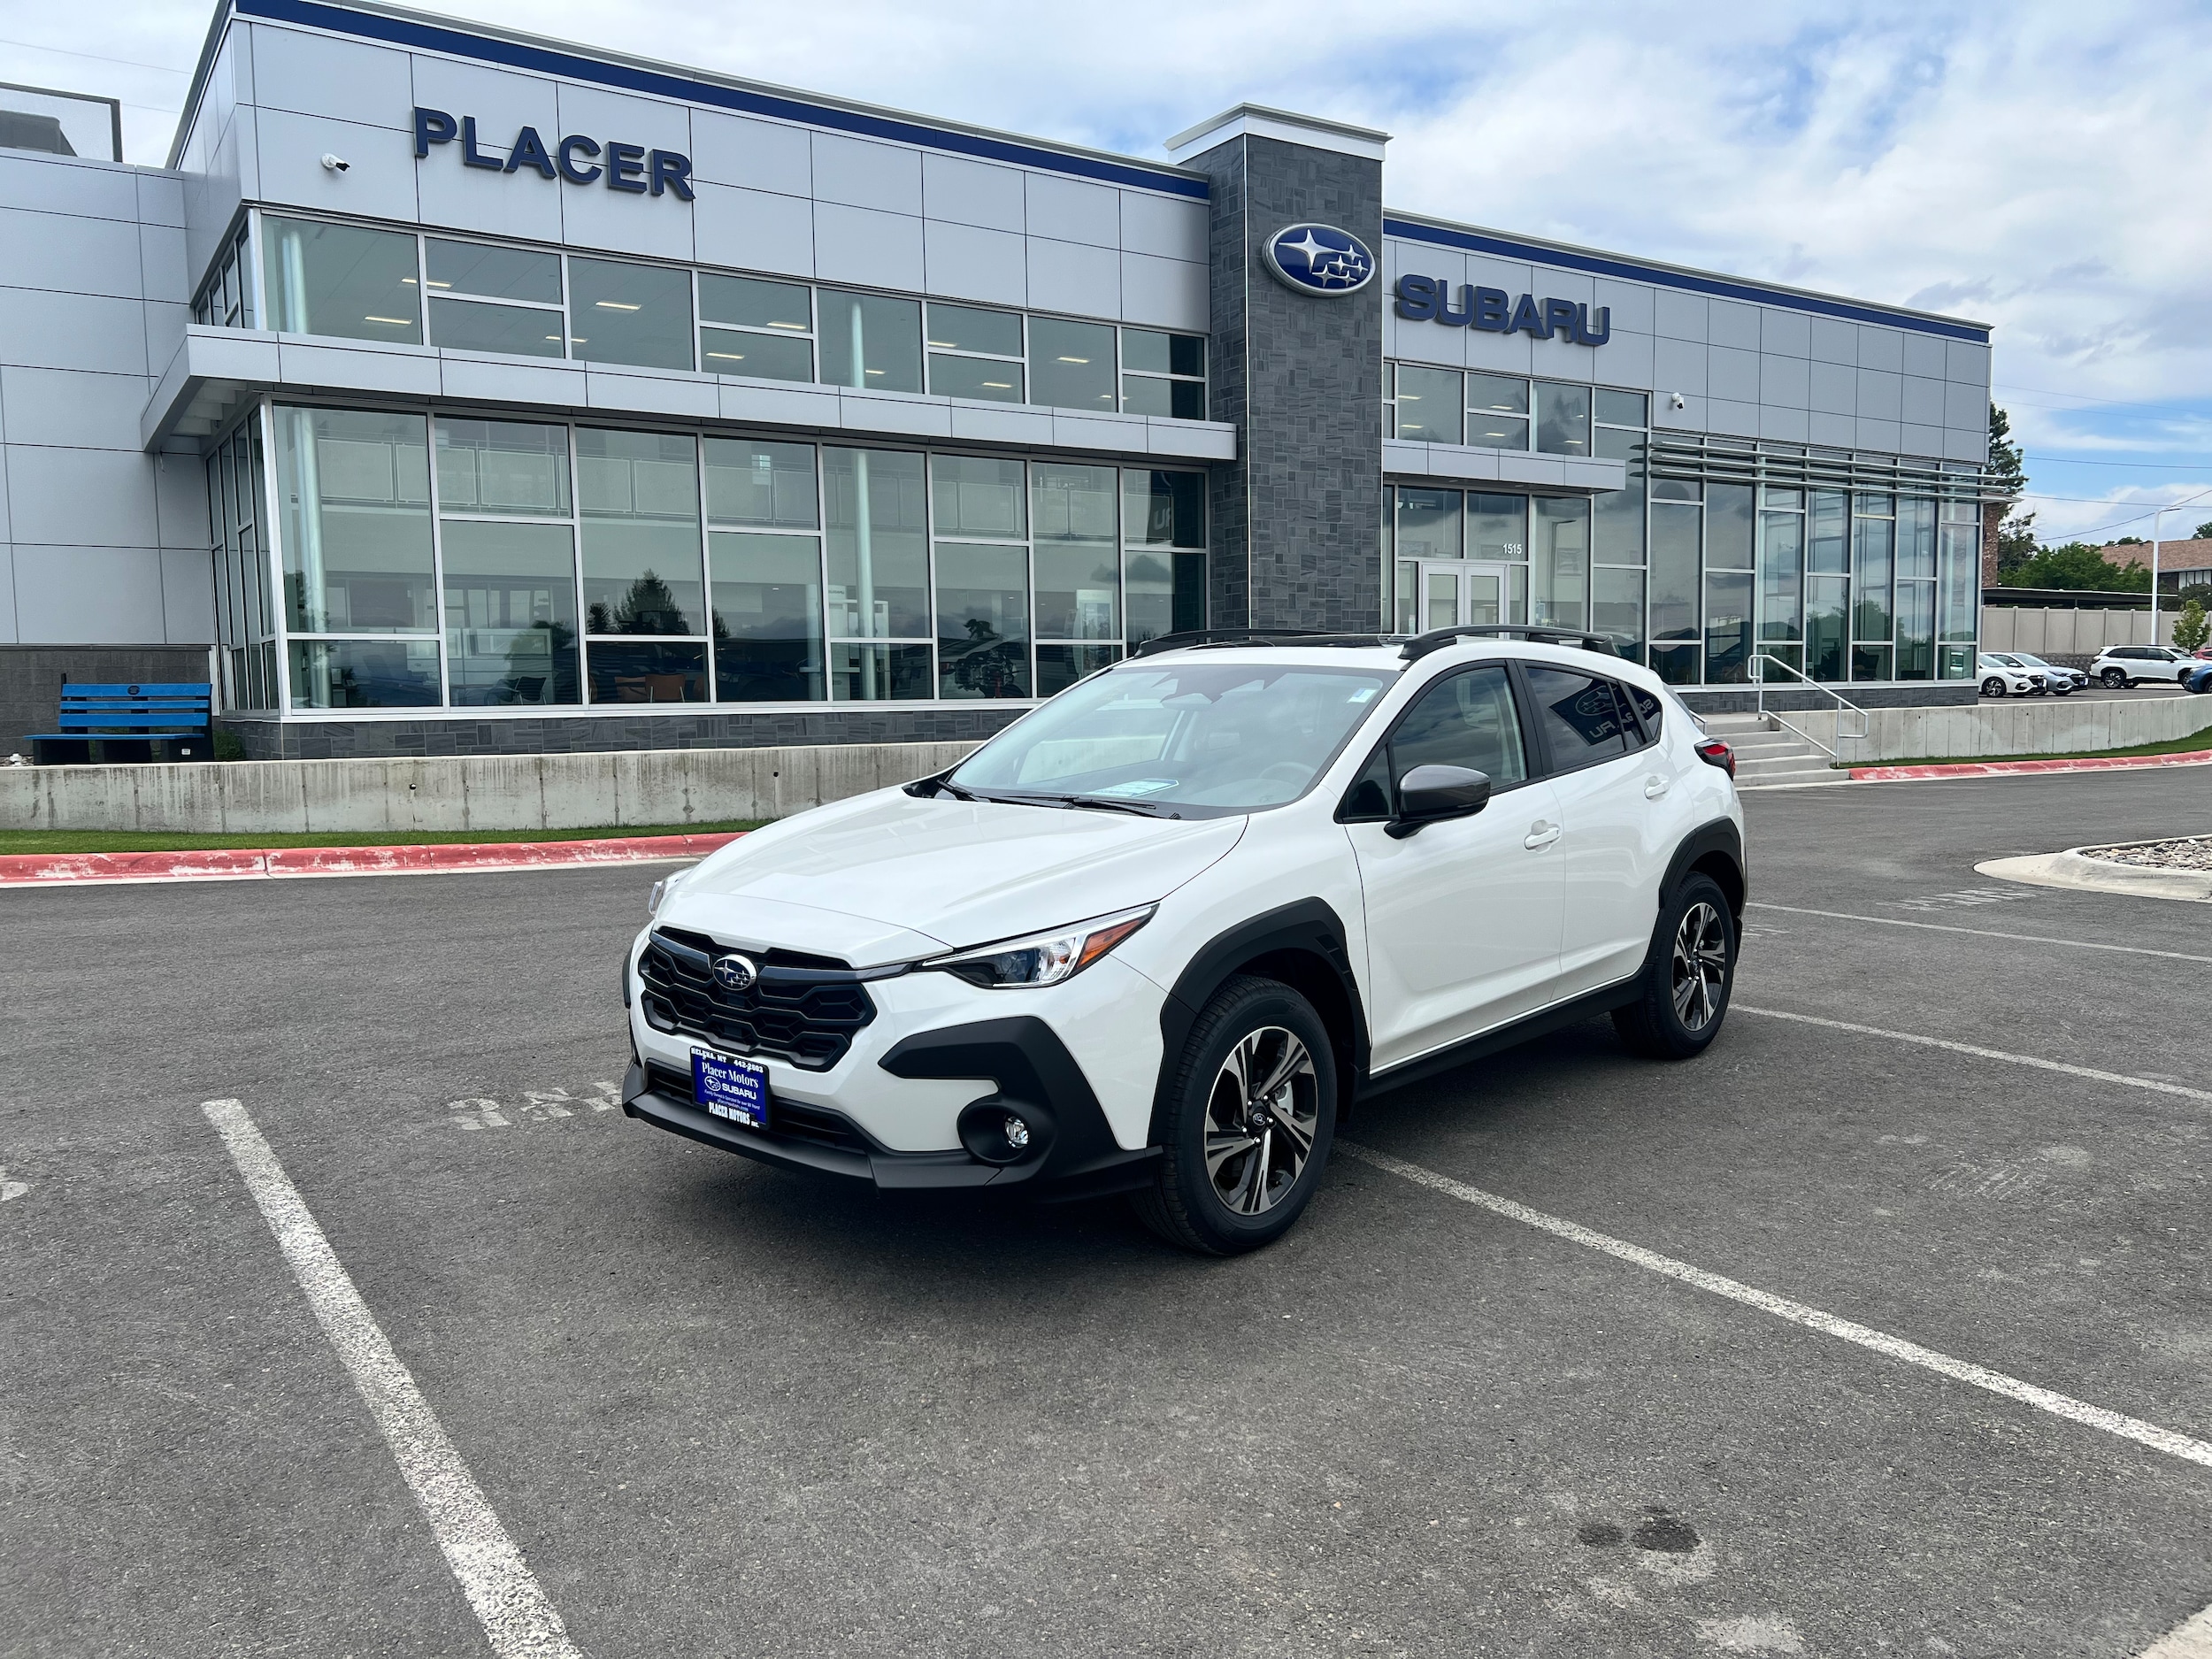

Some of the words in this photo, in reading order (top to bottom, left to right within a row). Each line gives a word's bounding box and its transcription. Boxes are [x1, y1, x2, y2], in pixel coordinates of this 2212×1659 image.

[413, 106, 695, 202] PLACER
[1396, 273, 1610, 346] SUBARU
[1502, 543, 1523, 555] 1515
[717, 1054, 727, 1063] MT
[702, 1061, 727, 1079] Placer
[728, 1069, 759, 1088] Motors
[722, 1083, 757, 1100] SUBARU
[709, 1102, 728, 1118] PLACER
[728, 1106, 750, 1125] MOTORS
